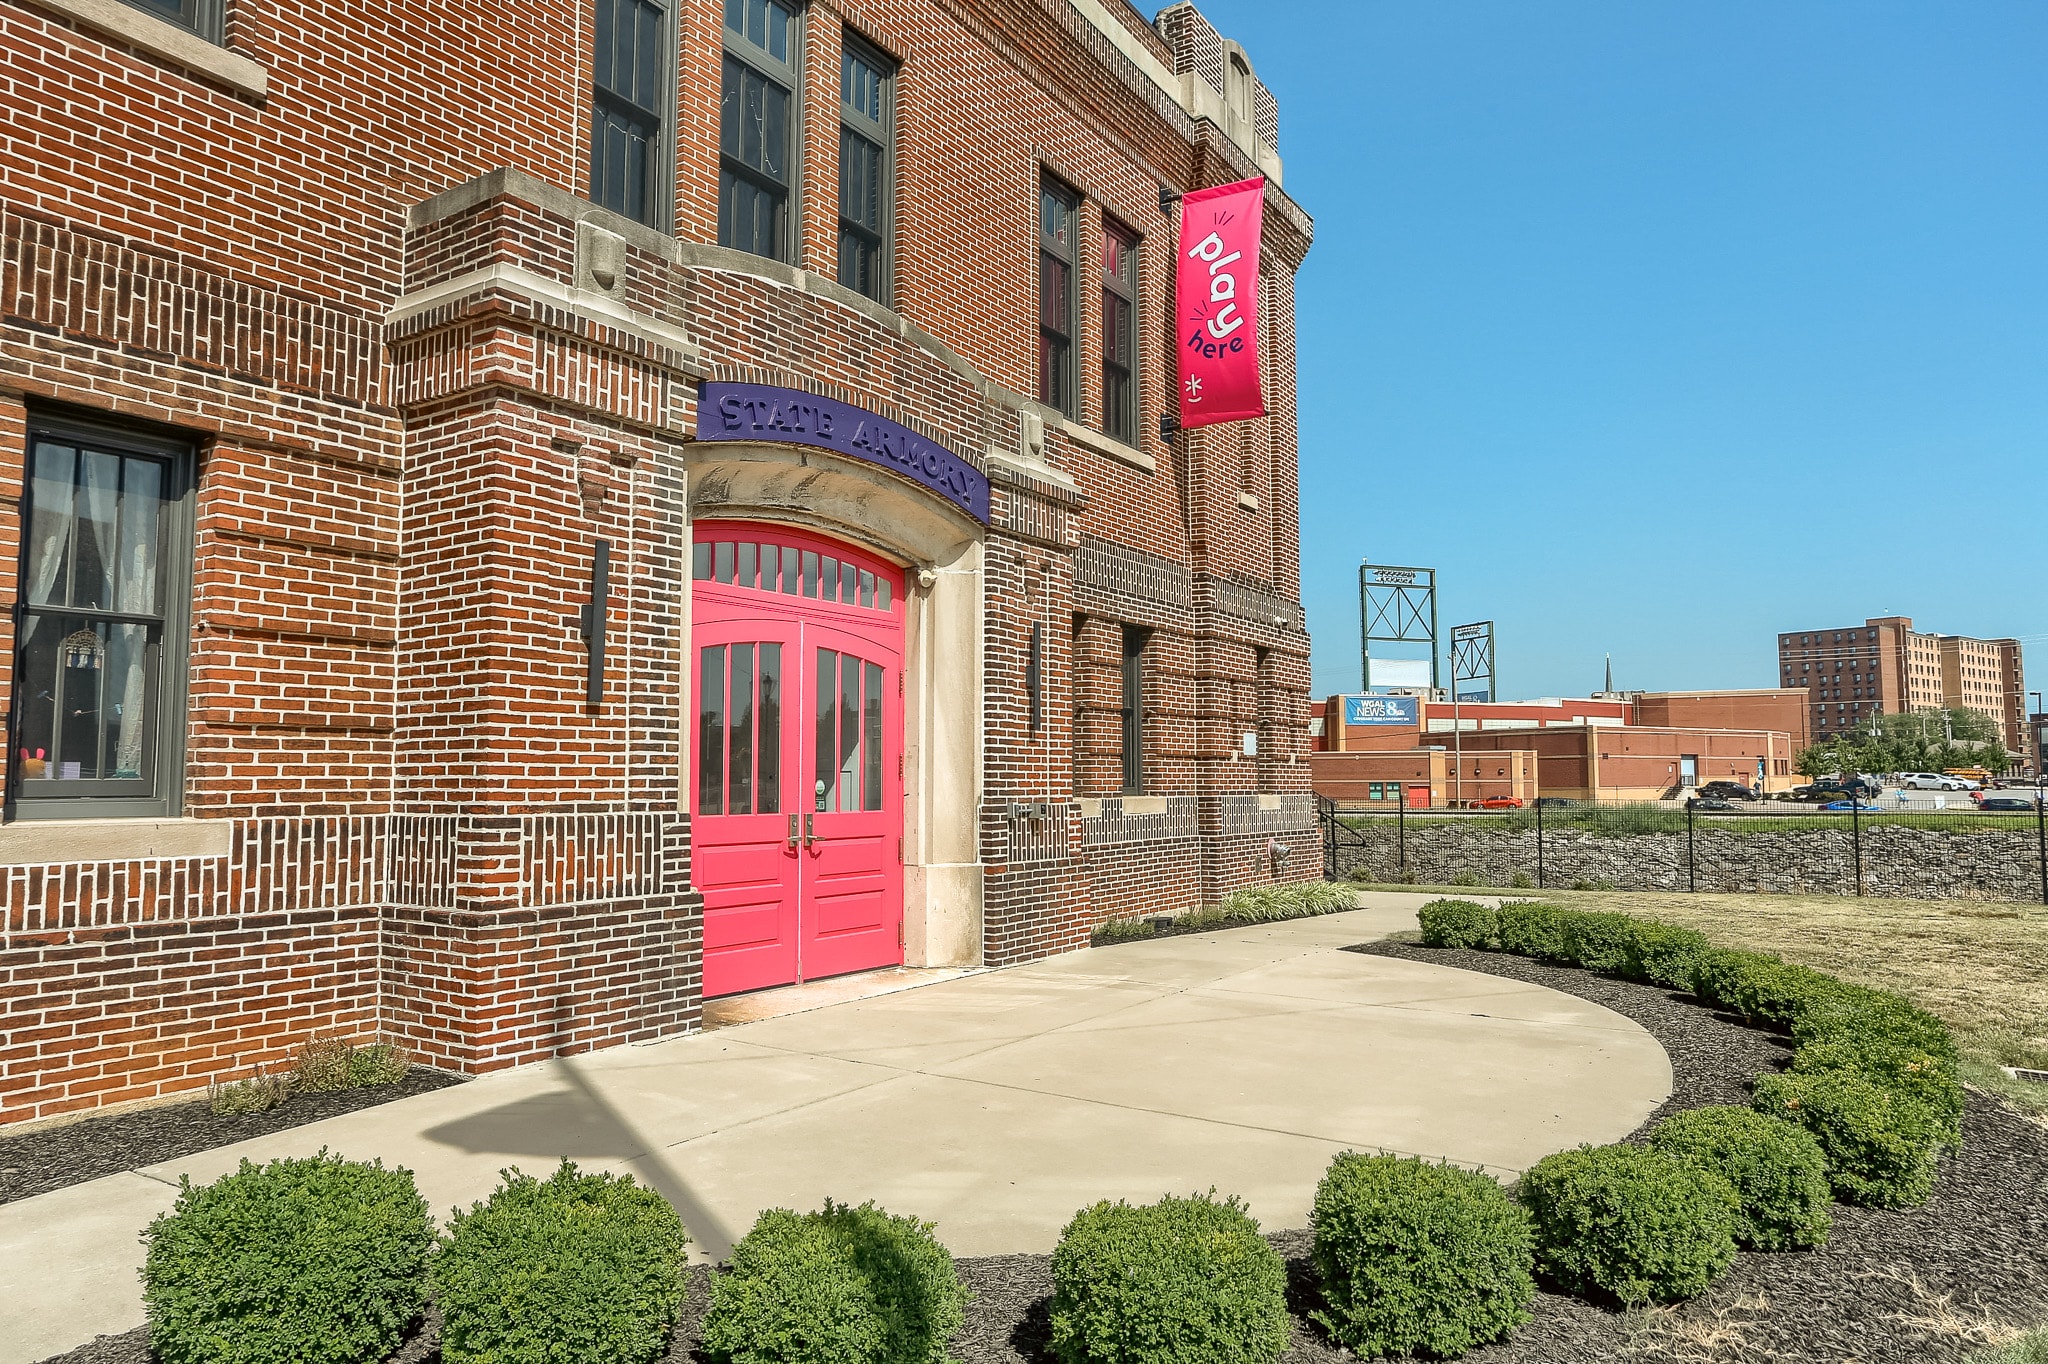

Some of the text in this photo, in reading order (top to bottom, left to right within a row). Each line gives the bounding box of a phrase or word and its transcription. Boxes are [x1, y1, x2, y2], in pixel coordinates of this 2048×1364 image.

[1187, 231, 1244, 339] play
[1187, 329, 1244, 359] here
[720, 394, 978, 506] STATE ARMORY
[1356, 707, 1386, 717] NEWS
[1361, 700, 1385, 708] WGAL
[1386, 701, 1397, 716] 8
